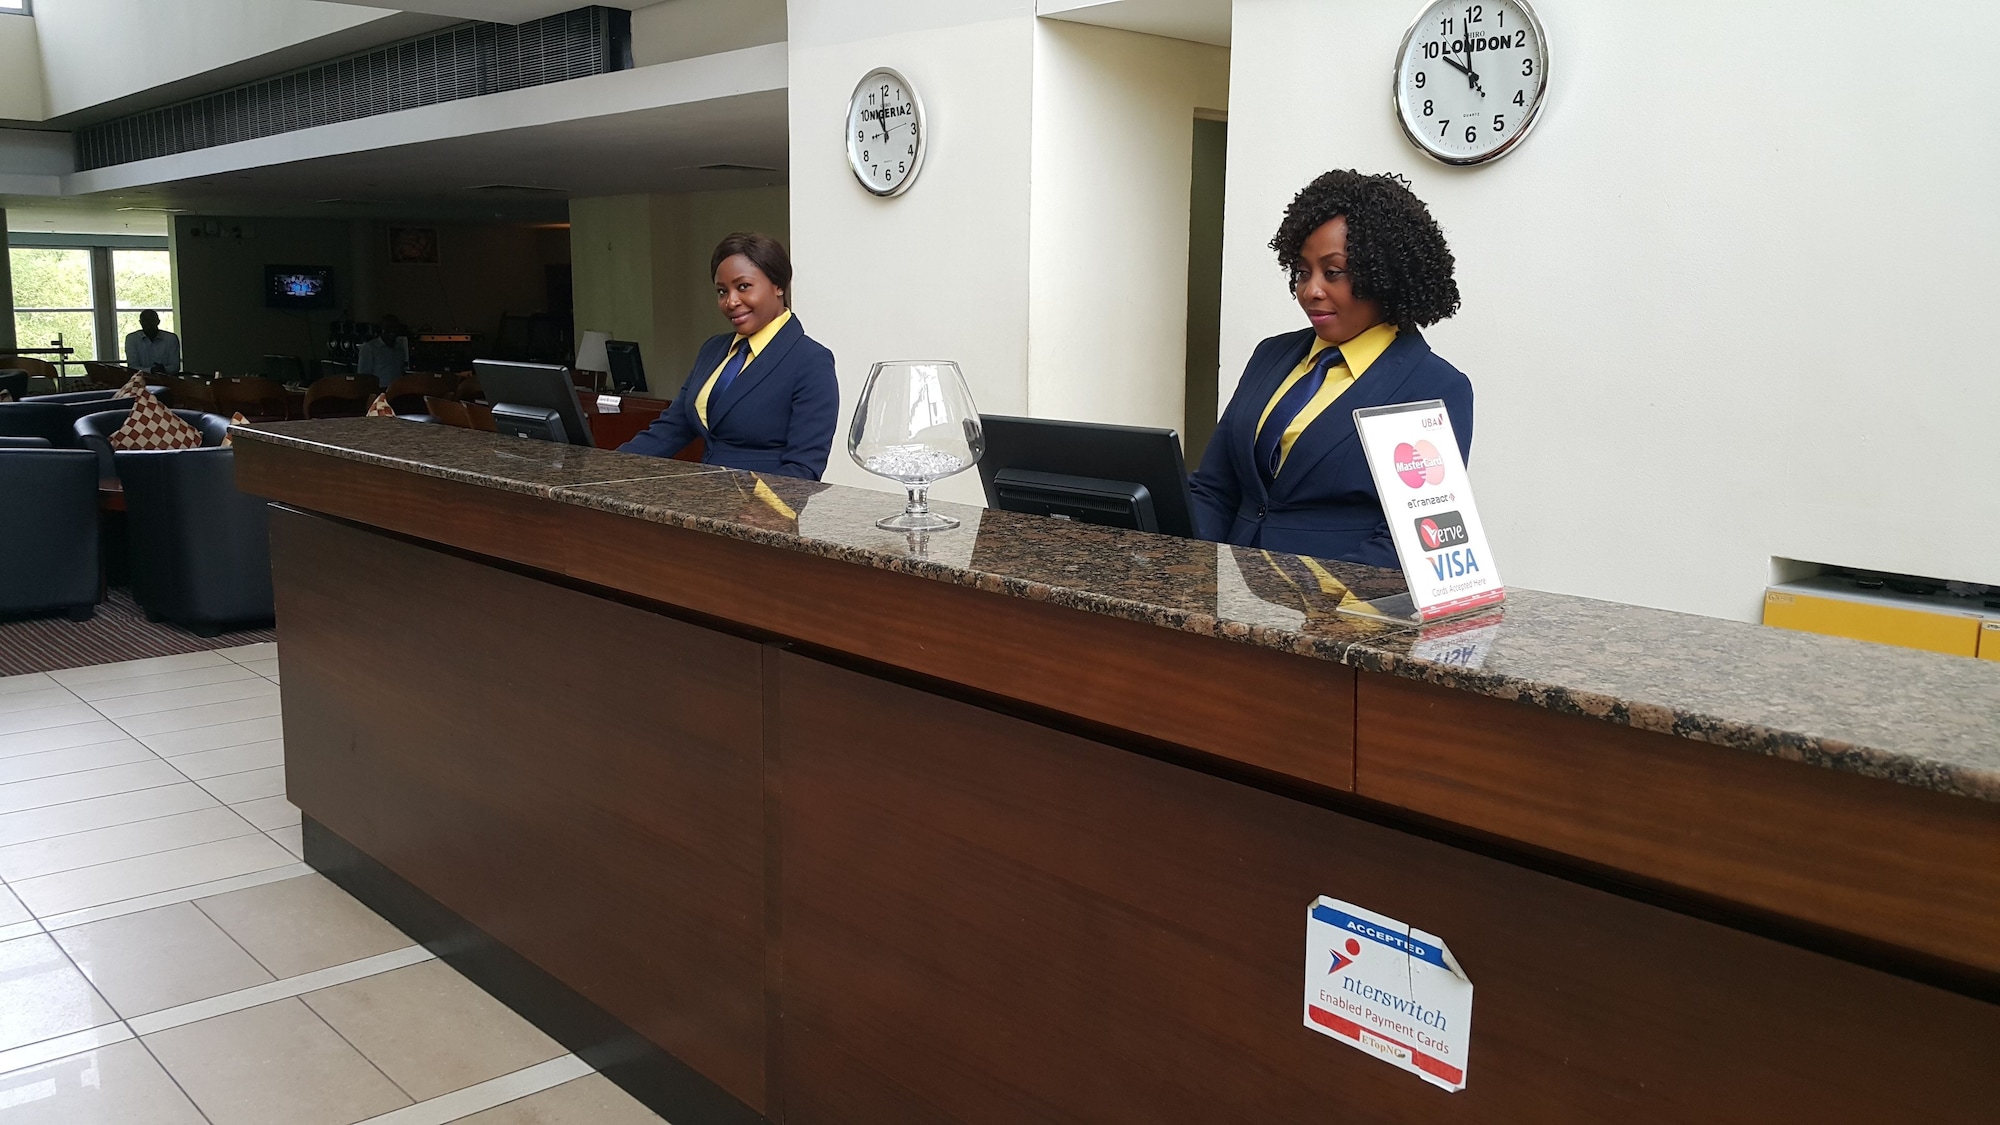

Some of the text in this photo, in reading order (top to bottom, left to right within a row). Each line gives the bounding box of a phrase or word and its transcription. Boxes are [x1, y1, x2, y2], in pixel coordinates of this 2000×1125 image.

[1465, 5, 1482, 24] 12
[1497, 10, 1504, 28] 1
[1440, 17, 1453, 36] 11
[1442, 35, 1512, 55] LONDON
[1515, 30, 1526, 48] 2
[1422, 41, 1439, 59] 10
[1522, 58, 1533, 76] 3
[1415, 72, 1426, 88] 9
[868, 93, 875, 105] 11
[880, 85, 889, 97] 12
[896, 88, 900, 101] 1
[1512, 90, 1525, 107] 4
[861, 109, 869, 122] 10
[870, 106, 906, 120] NIGERIA
[905, 102, 912, 115] 2
[1423, 99, 1434, 116] 8
[910, 123, 916, 135] 3
[1438, 120, 1450, 137] 7
[1493, 114, 1505, 132] 5
[858, 130, 864, 142] 9
[1465, 126, 1477, 143] 6
[863, 150, 869, 162] 8
[908, 144, 913, 156] 4
[872, 164, 878, 177] 7
[885, 169, 892, 181] 6
[898, 161, 905, 174] 5
[1421, 418, 1438, 428] UBA
[1395, 456, 1443, 473] MasterCard
[1421, 524, 1464, 545] Verve
[1425, 547, 1480, 581] VISA
[1432, 577, 1487, 598] Cards Accepted Here
[1347, 921, 1426, 956] ACCEPTED
[1319, 989, 1449, 1055] Enabled Payment Cards
